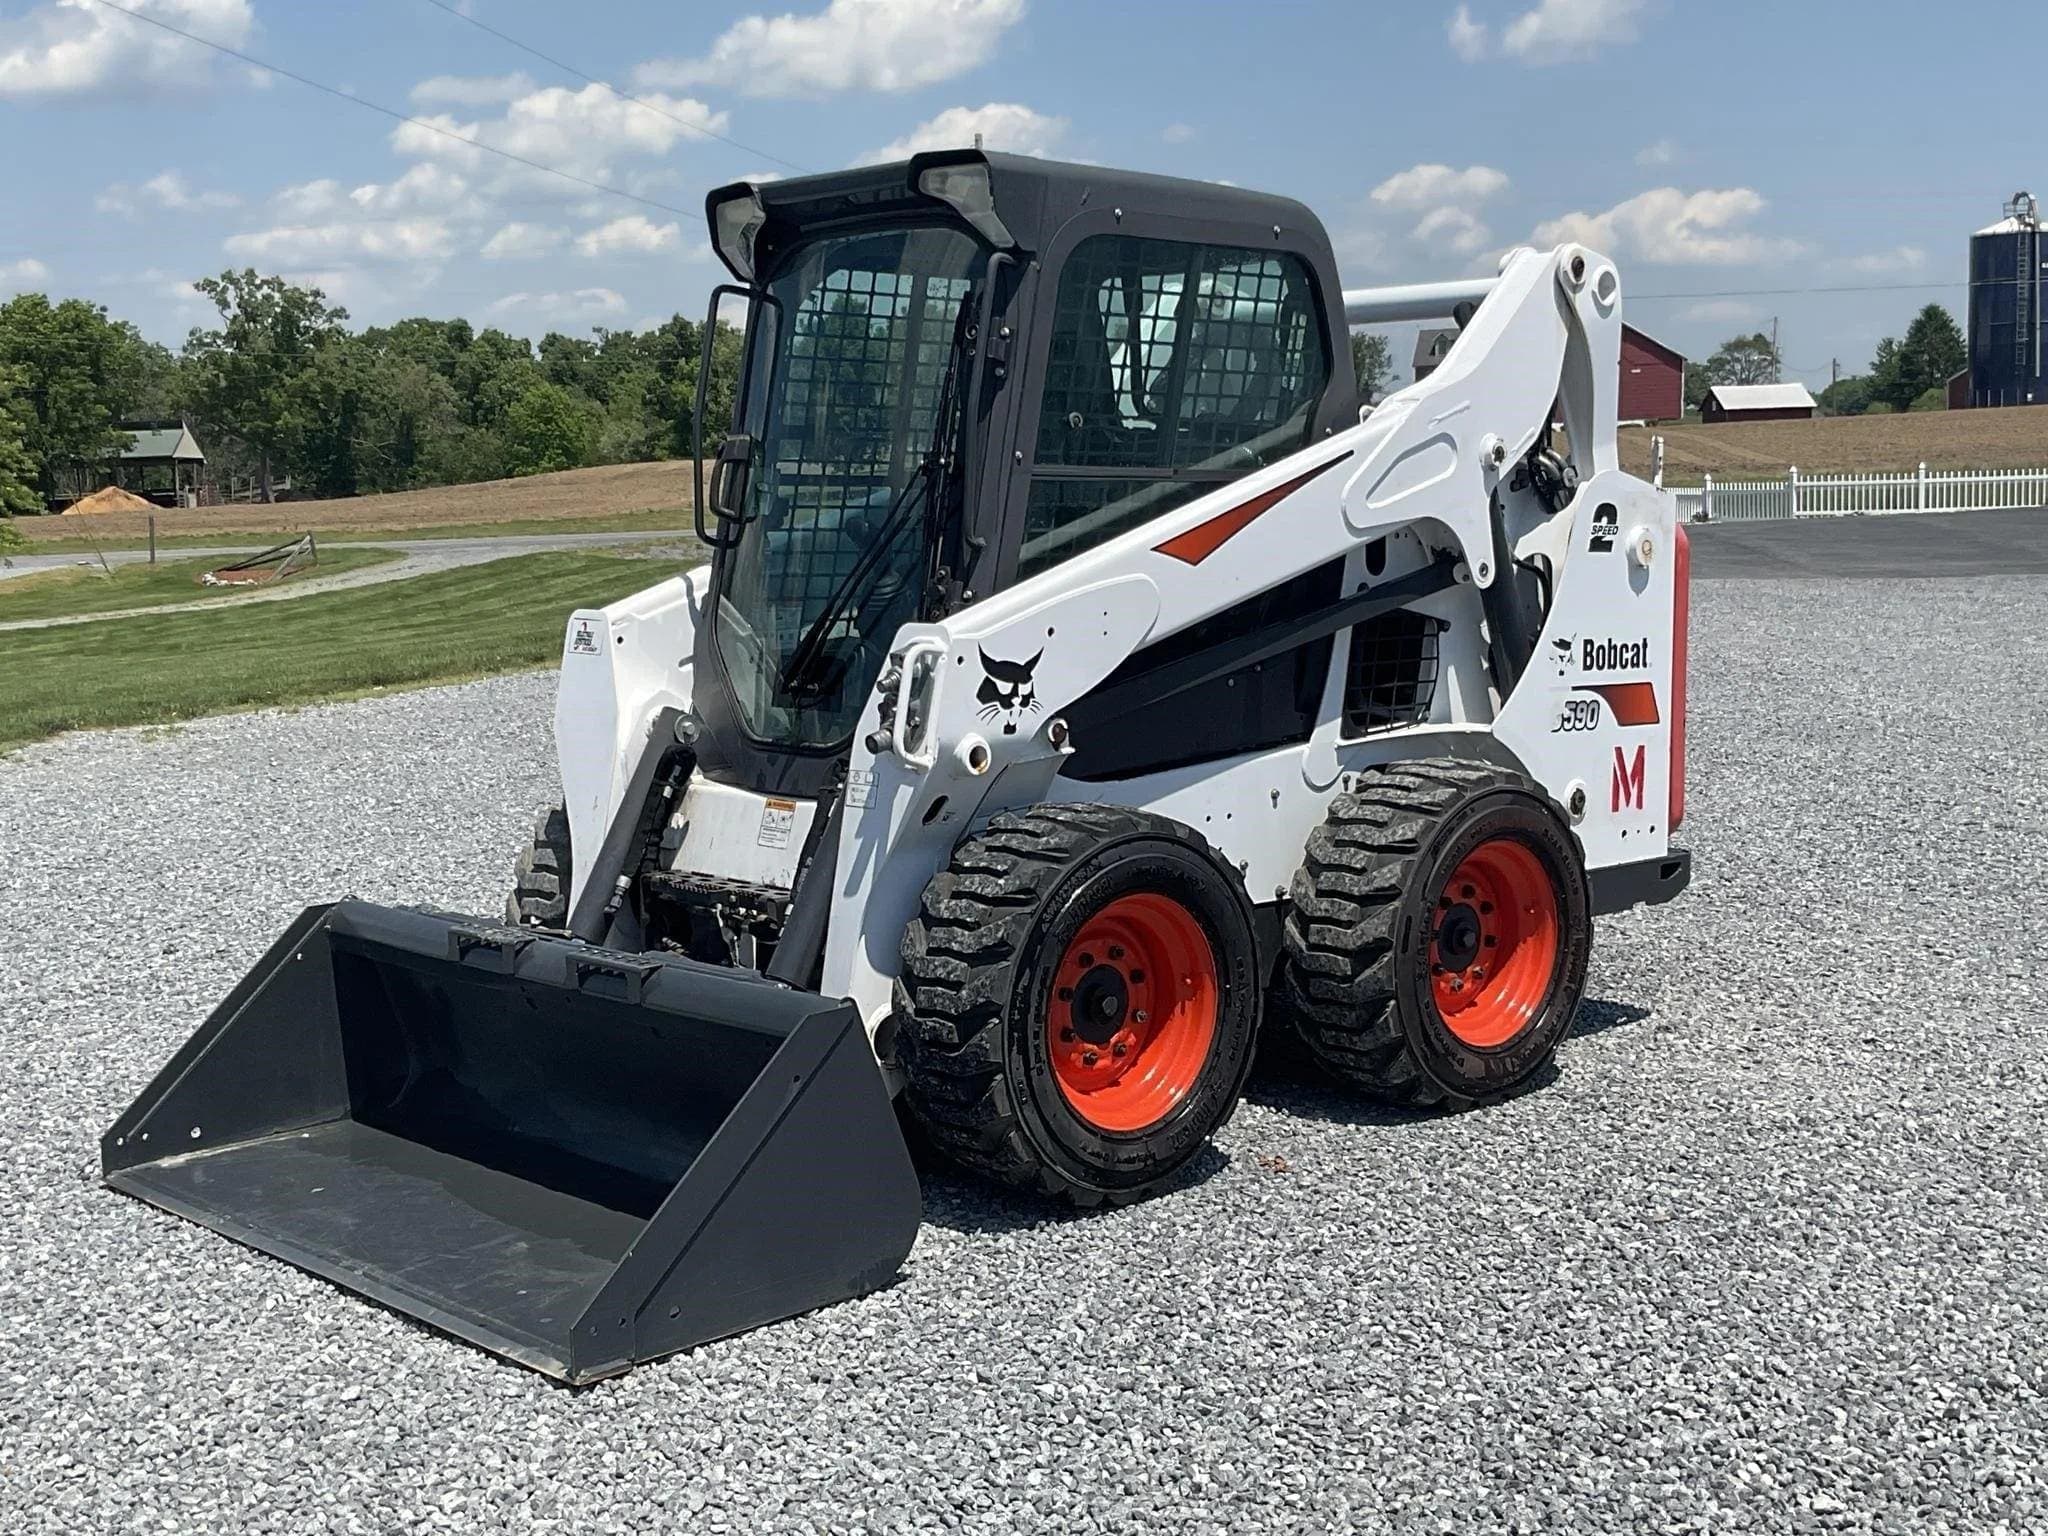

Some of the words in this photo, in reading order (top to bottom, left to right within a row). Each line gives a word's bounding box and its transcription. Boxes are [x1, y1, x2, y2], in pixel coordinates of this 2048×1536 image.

[1588, 502, 1618, 553] 2
[1590, 524, 1619, 536] SPEED
[1582, 637, 1648, 671] Bobcat
[1611, 745, 1645, 812] M
